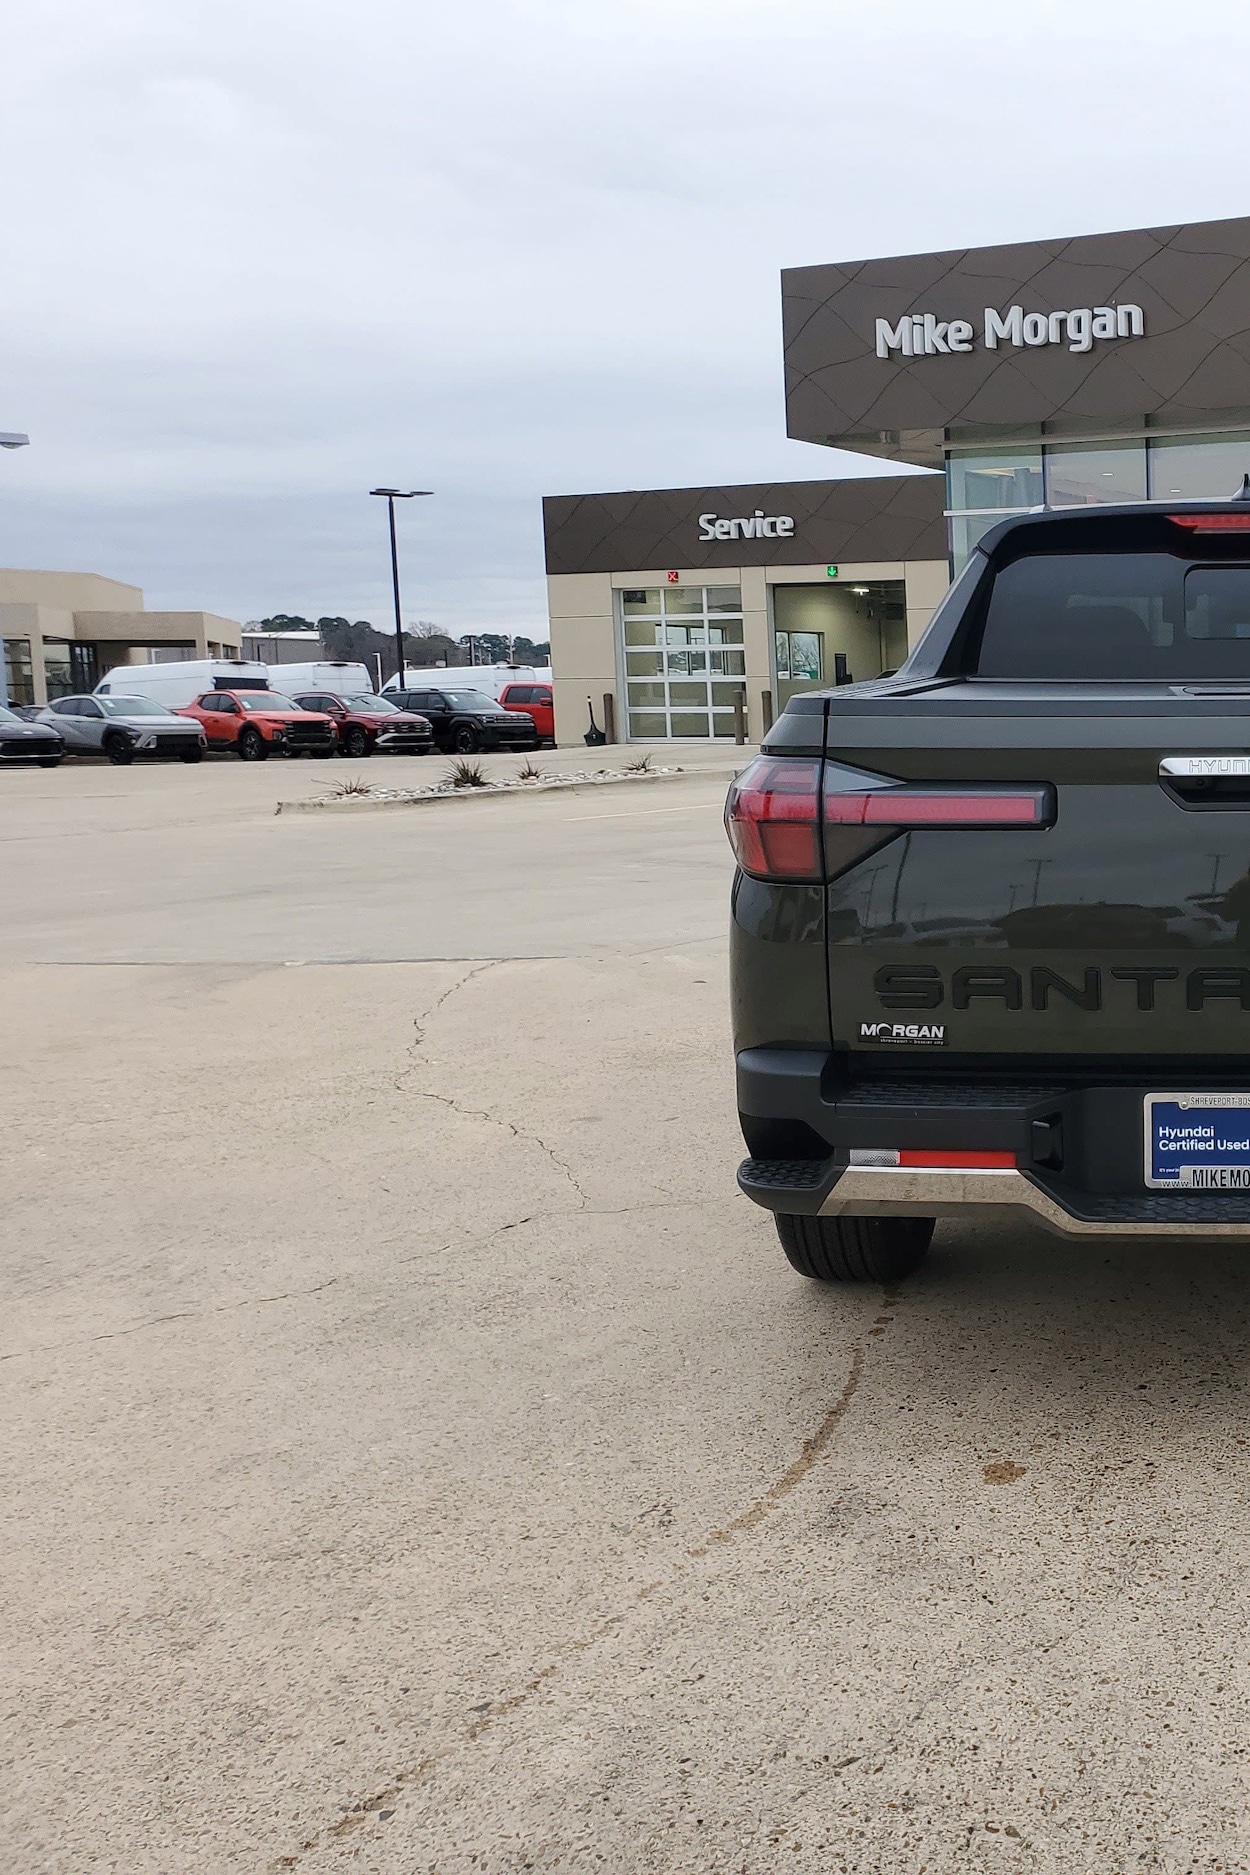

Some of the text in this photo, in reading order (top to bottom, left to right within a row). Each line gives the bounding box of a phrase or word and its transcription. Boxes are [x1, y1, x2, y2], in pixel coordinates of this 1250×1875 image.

[875, 304, 1144, 359] Mike Morgan
[698, 510, 795, 541] Service
[860, 1023, 944, 1038] MORGAN
[1159, 1125, 1215, 1140] Hyundai
[1159, 1139, 1215, 1151] Certified
[1217, 1139, 1250, 1151] Used
